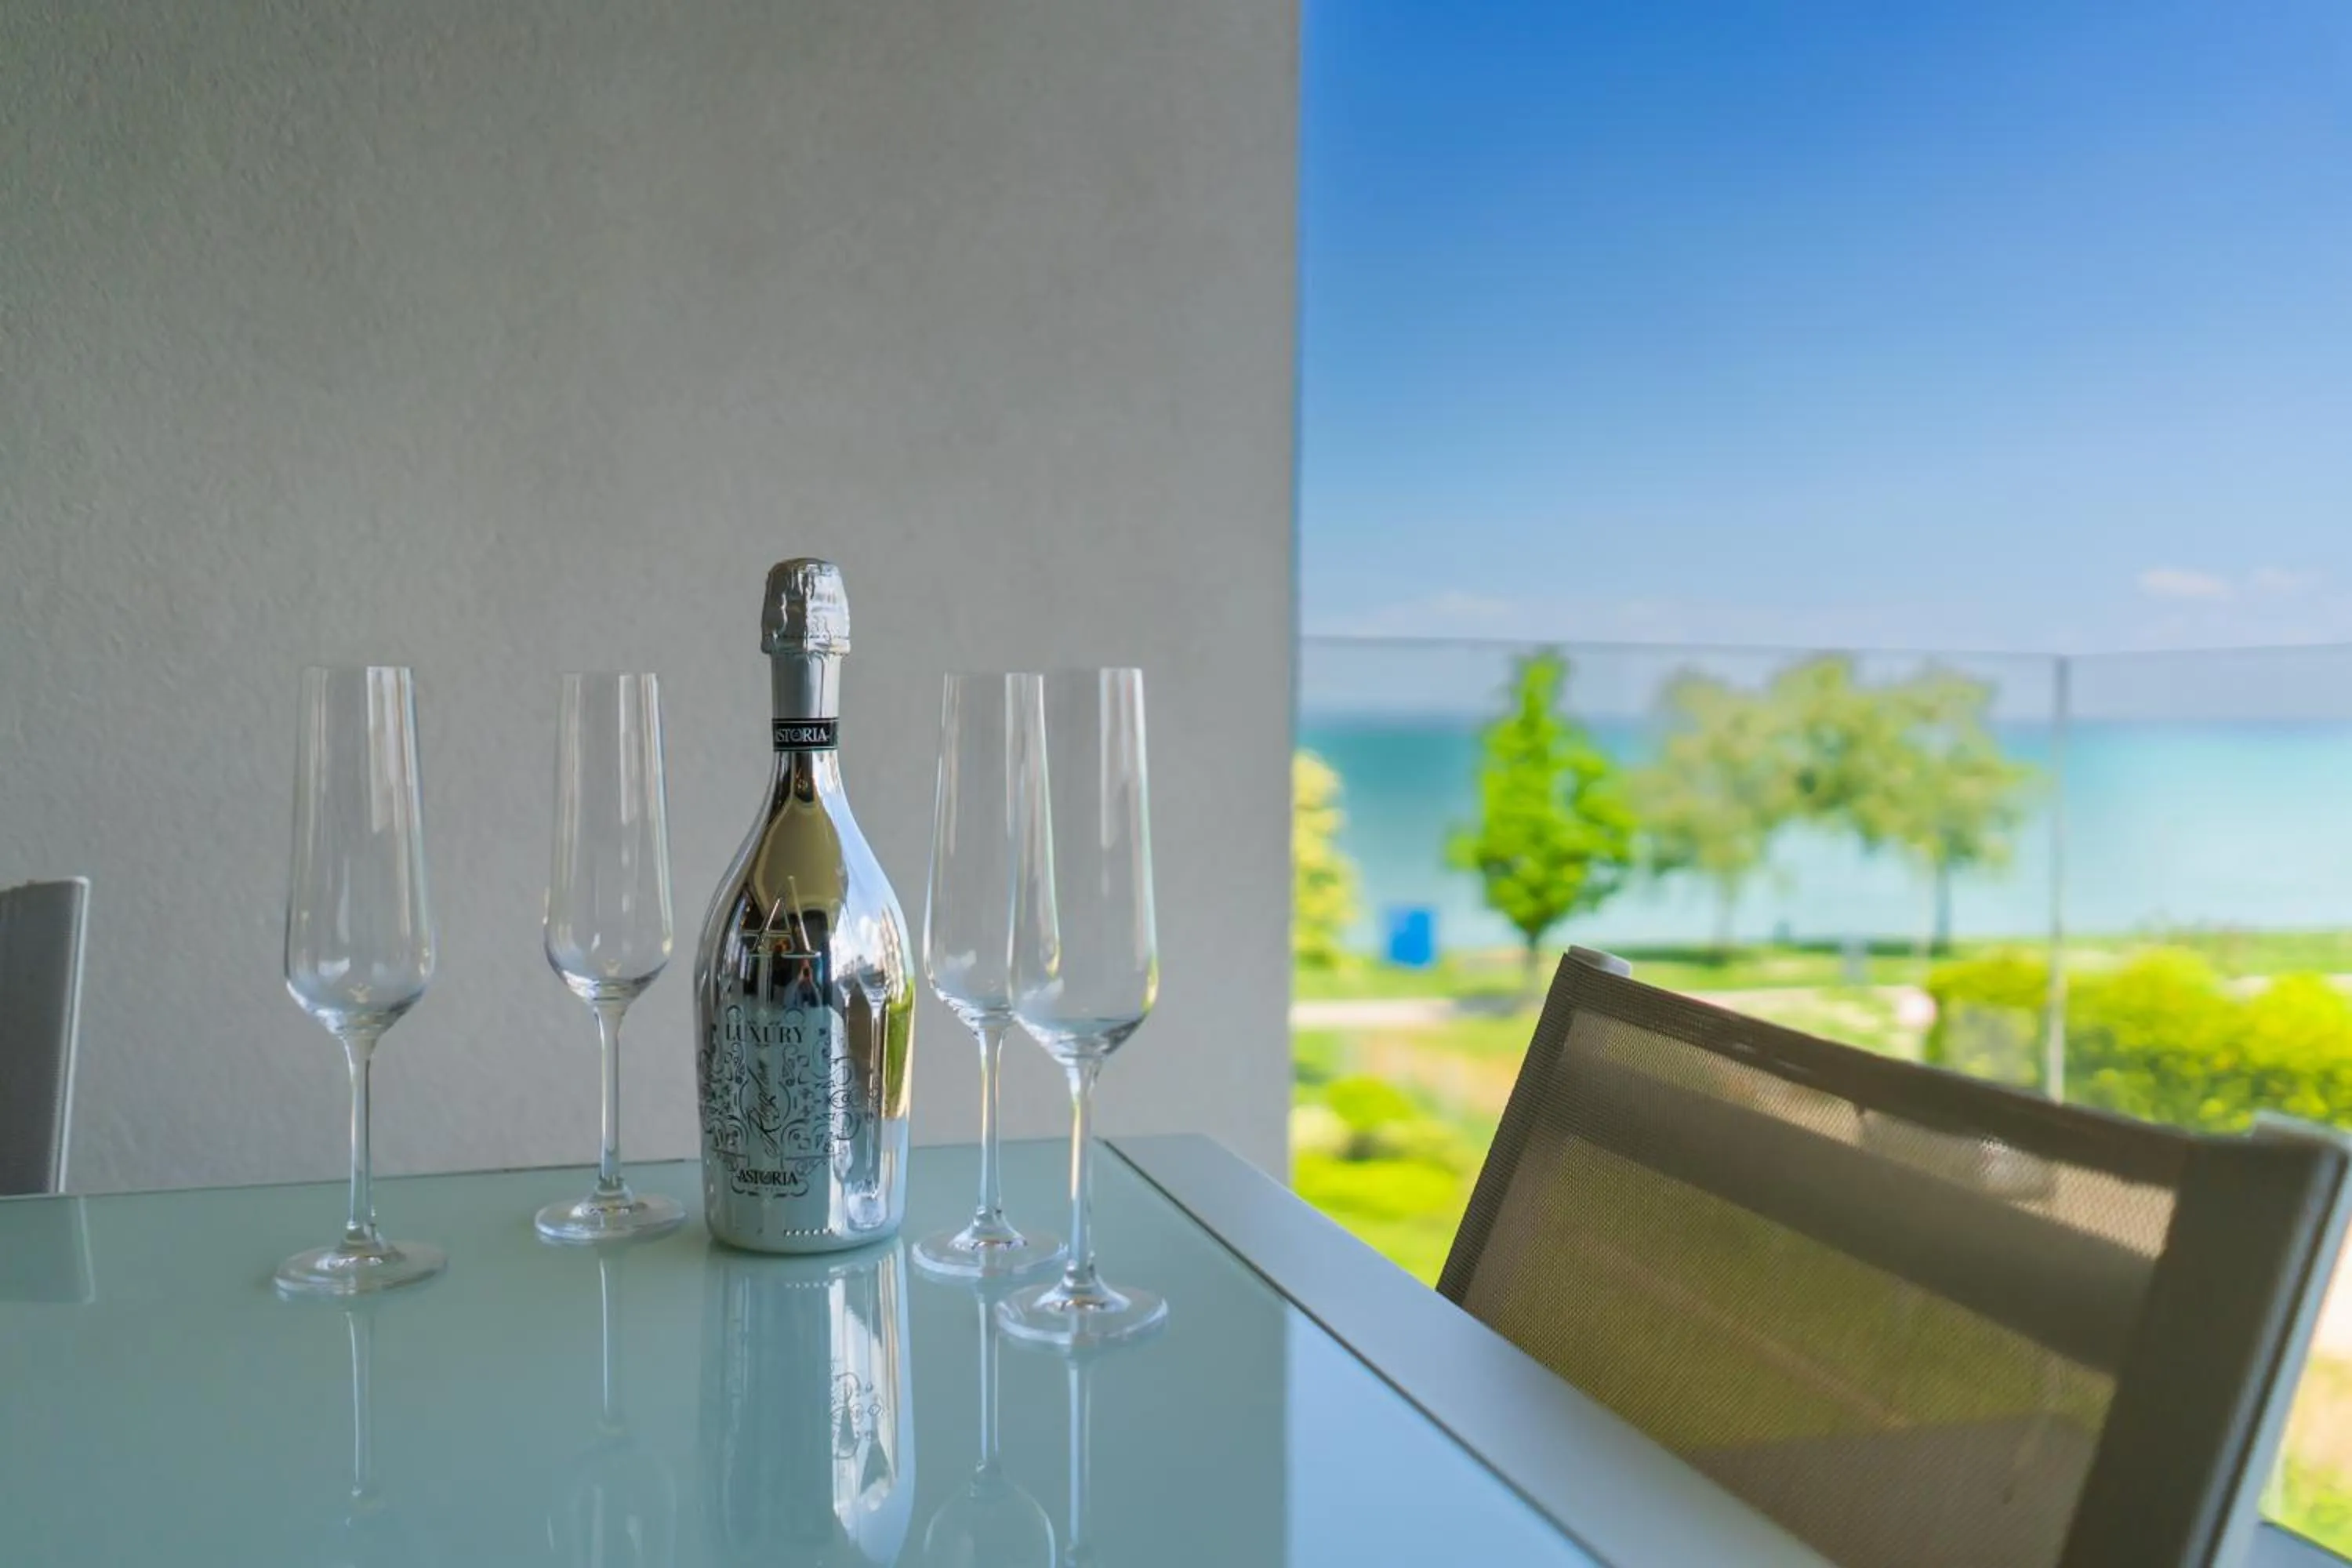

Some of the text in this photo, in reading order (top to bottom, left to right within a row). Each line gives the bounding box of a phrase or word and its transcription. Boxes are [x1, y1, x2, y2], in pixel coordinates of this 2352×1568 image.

[775, 727, 828, 742] STORIA
[726, 1023, 804, 1044] LUXURY
[737, 1169, 799, 1186] ASTORIA
